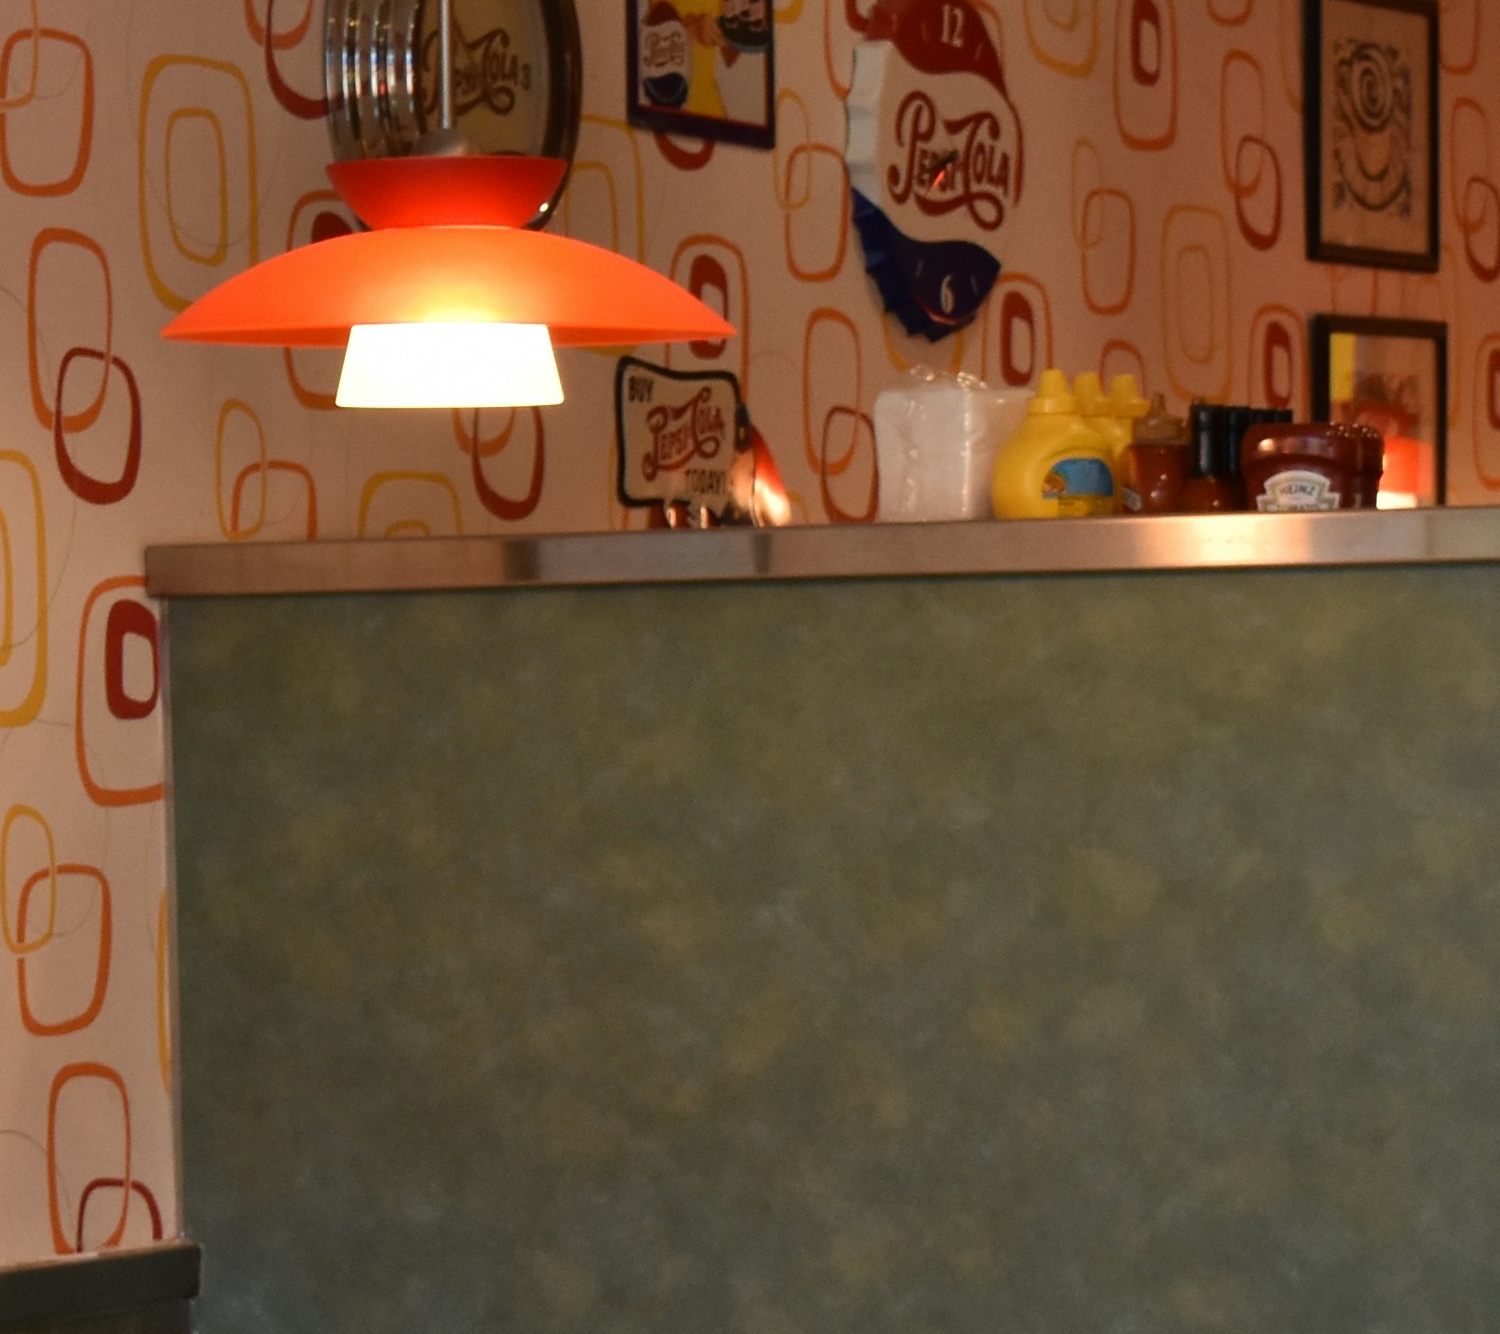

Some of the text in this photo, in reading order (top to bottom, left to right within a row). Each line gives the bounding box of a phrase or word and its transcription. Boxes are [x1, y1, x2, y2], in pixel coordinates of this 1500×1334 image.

[941, 5, 964, 48] 12
[940, 275, 954, 314] 6
[629, 375, 654, 403] BUY
[1278, 484, 1316, 496] HEINZ
